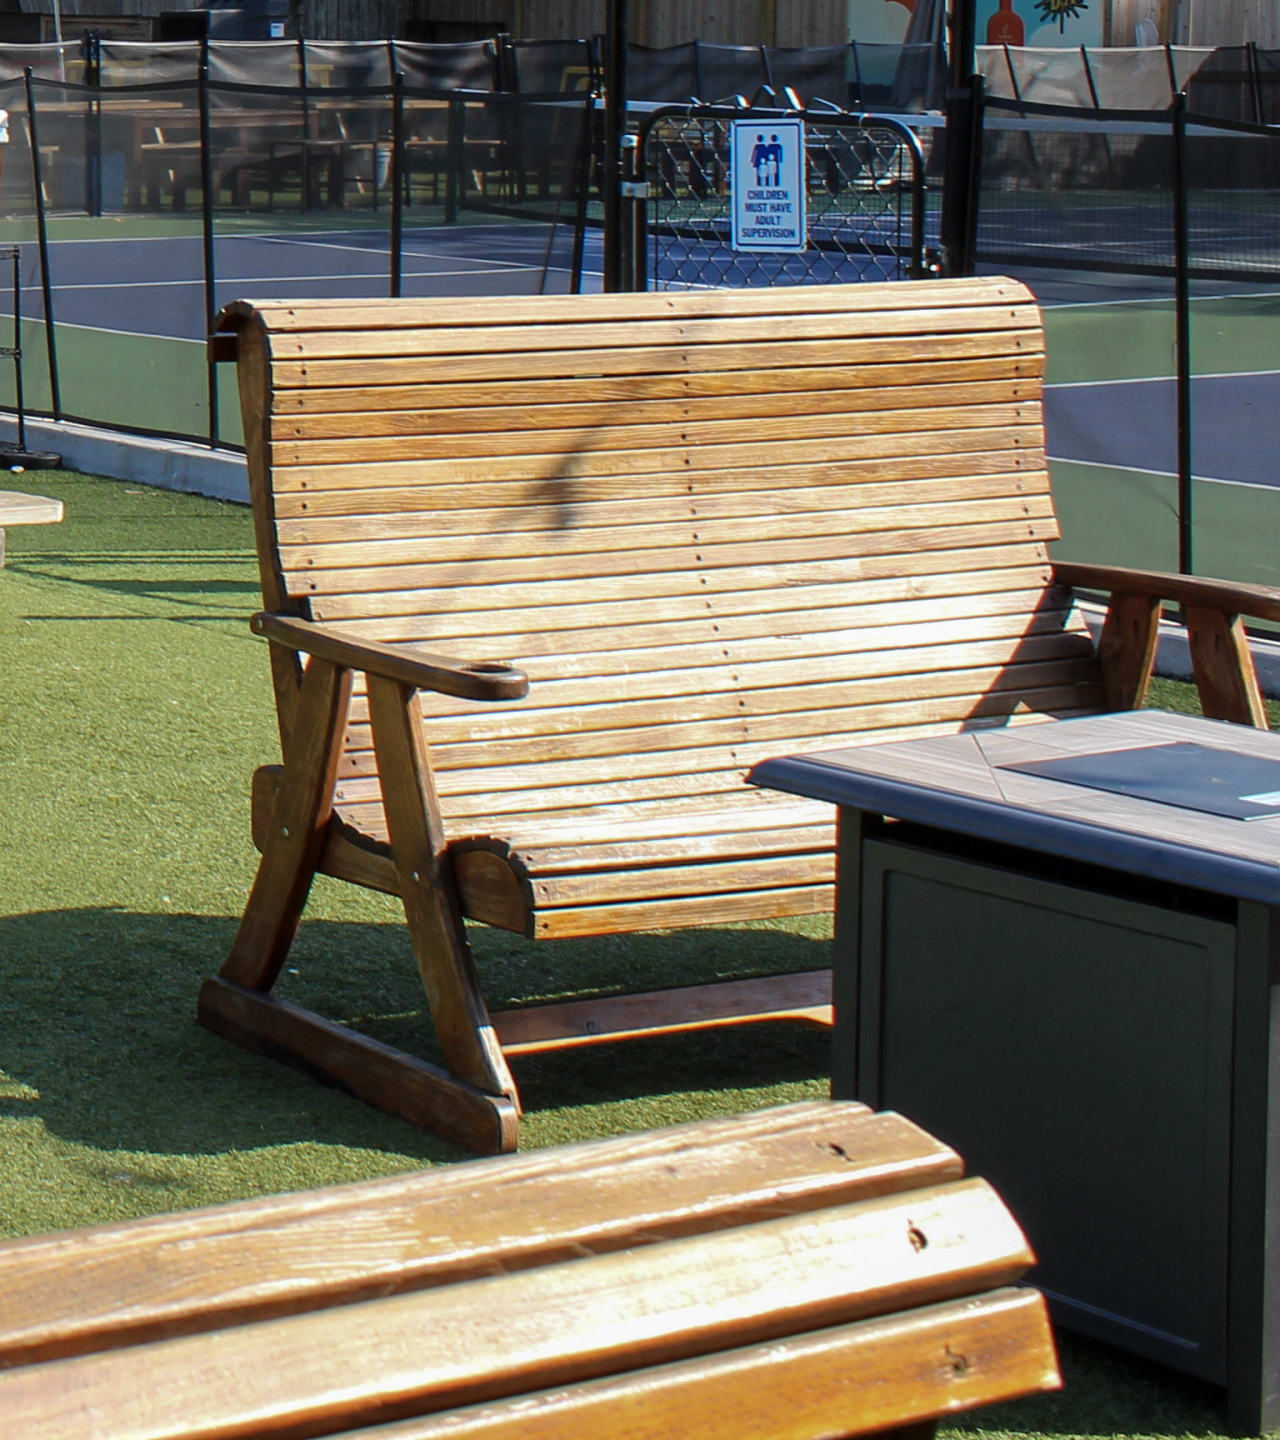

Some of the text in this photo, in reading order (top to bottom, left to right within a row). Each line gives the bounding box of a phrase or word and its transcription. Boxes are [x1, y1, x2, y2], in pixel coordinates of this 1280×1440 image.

[747, 190, 789, 200] CHILDREN
[744, 202, 792, 212] MUST HAVE
[754, 215, 781, 225] ADULT
[741, 227, 795, 238] SUPERVISION
